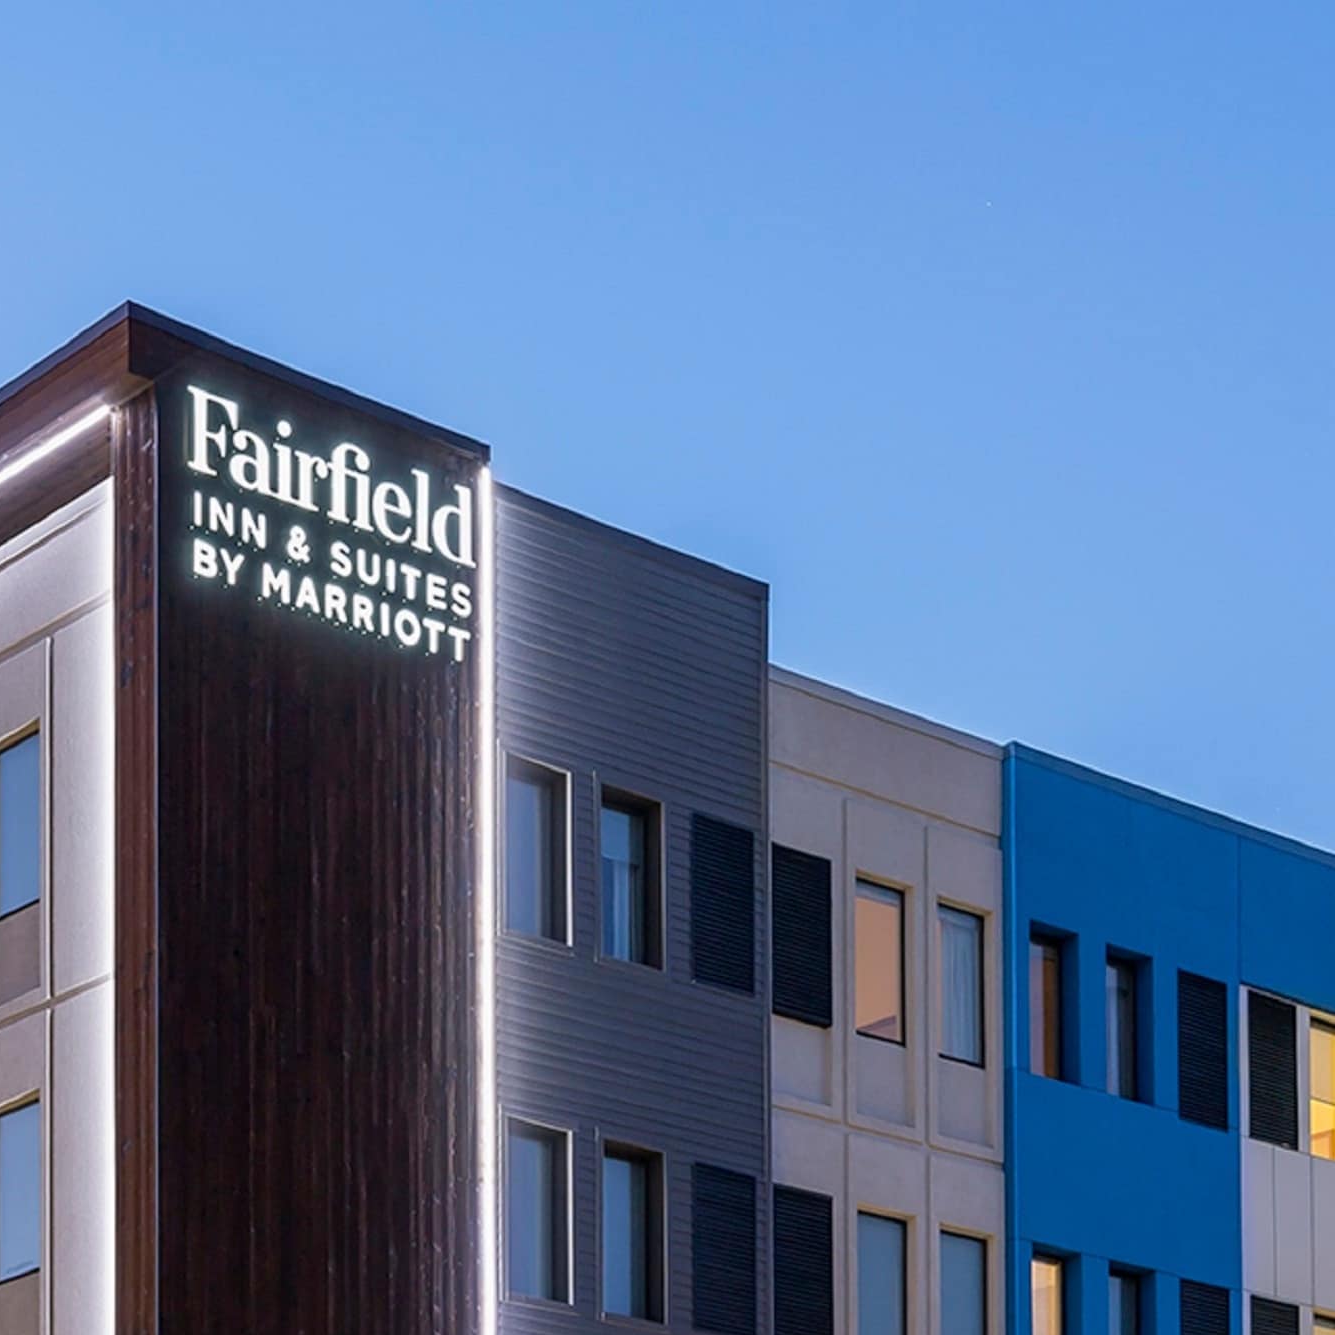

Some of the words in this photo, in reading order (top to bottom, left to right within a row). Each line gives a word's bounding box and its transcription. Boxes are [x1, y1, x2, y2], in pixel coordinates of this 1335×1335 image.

[187, 385, 476, 568] Fairfield
[193, 491, 267, 549] INN
[287, 525, 311, 563] &
[330, 542, 473, 618] SUITES
[193, 539, 245, 585] BY
[262, 562, 472, 663] MARRIOTT
